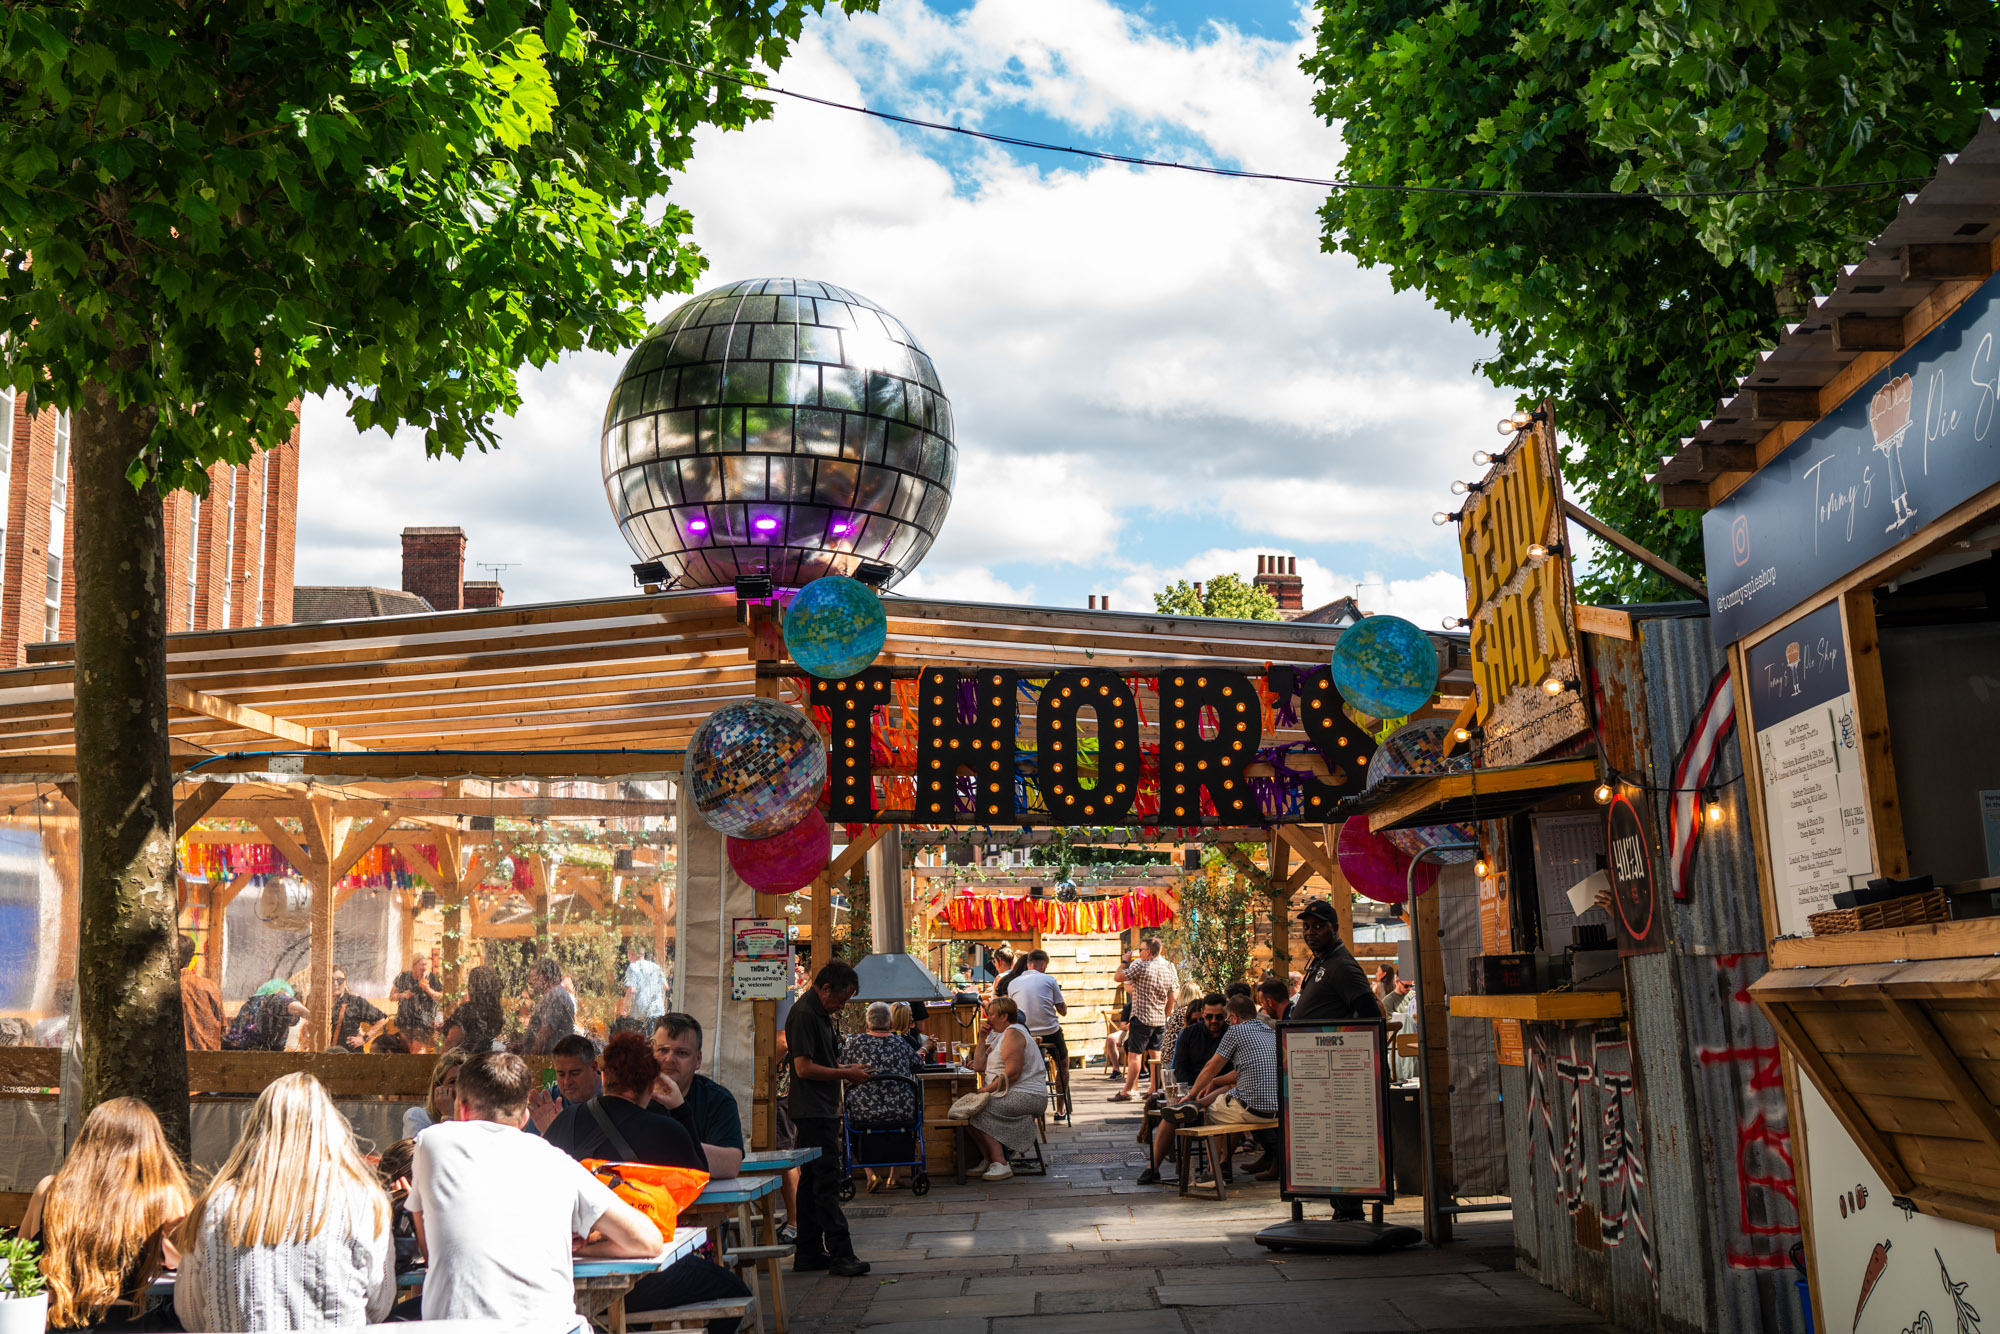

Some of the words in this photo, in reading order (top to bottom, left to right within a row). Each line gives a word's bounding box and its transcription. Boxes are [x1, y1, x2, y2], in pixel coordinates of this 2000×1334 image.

[1803, 446, 1876, 556] Tommy's
[1924, 369, 1961, 475] Pie
[1461, 432, 1555, 619] SEOUL
[1717, 565, 1777, 614] @tommyspieshop
[1469, 559, 1572, 727] SHACK
[810, 665, 1380, 825] THOR'S
[1844, 808, 1853, 817] MEAL
[1853, 806, 1864, 816] DEAL
[1612, 834, 1645, 882] YUZU
[1479, 876, 1497, 900] MENU
[1315, 1035, 1344, 1047] THOR'S
